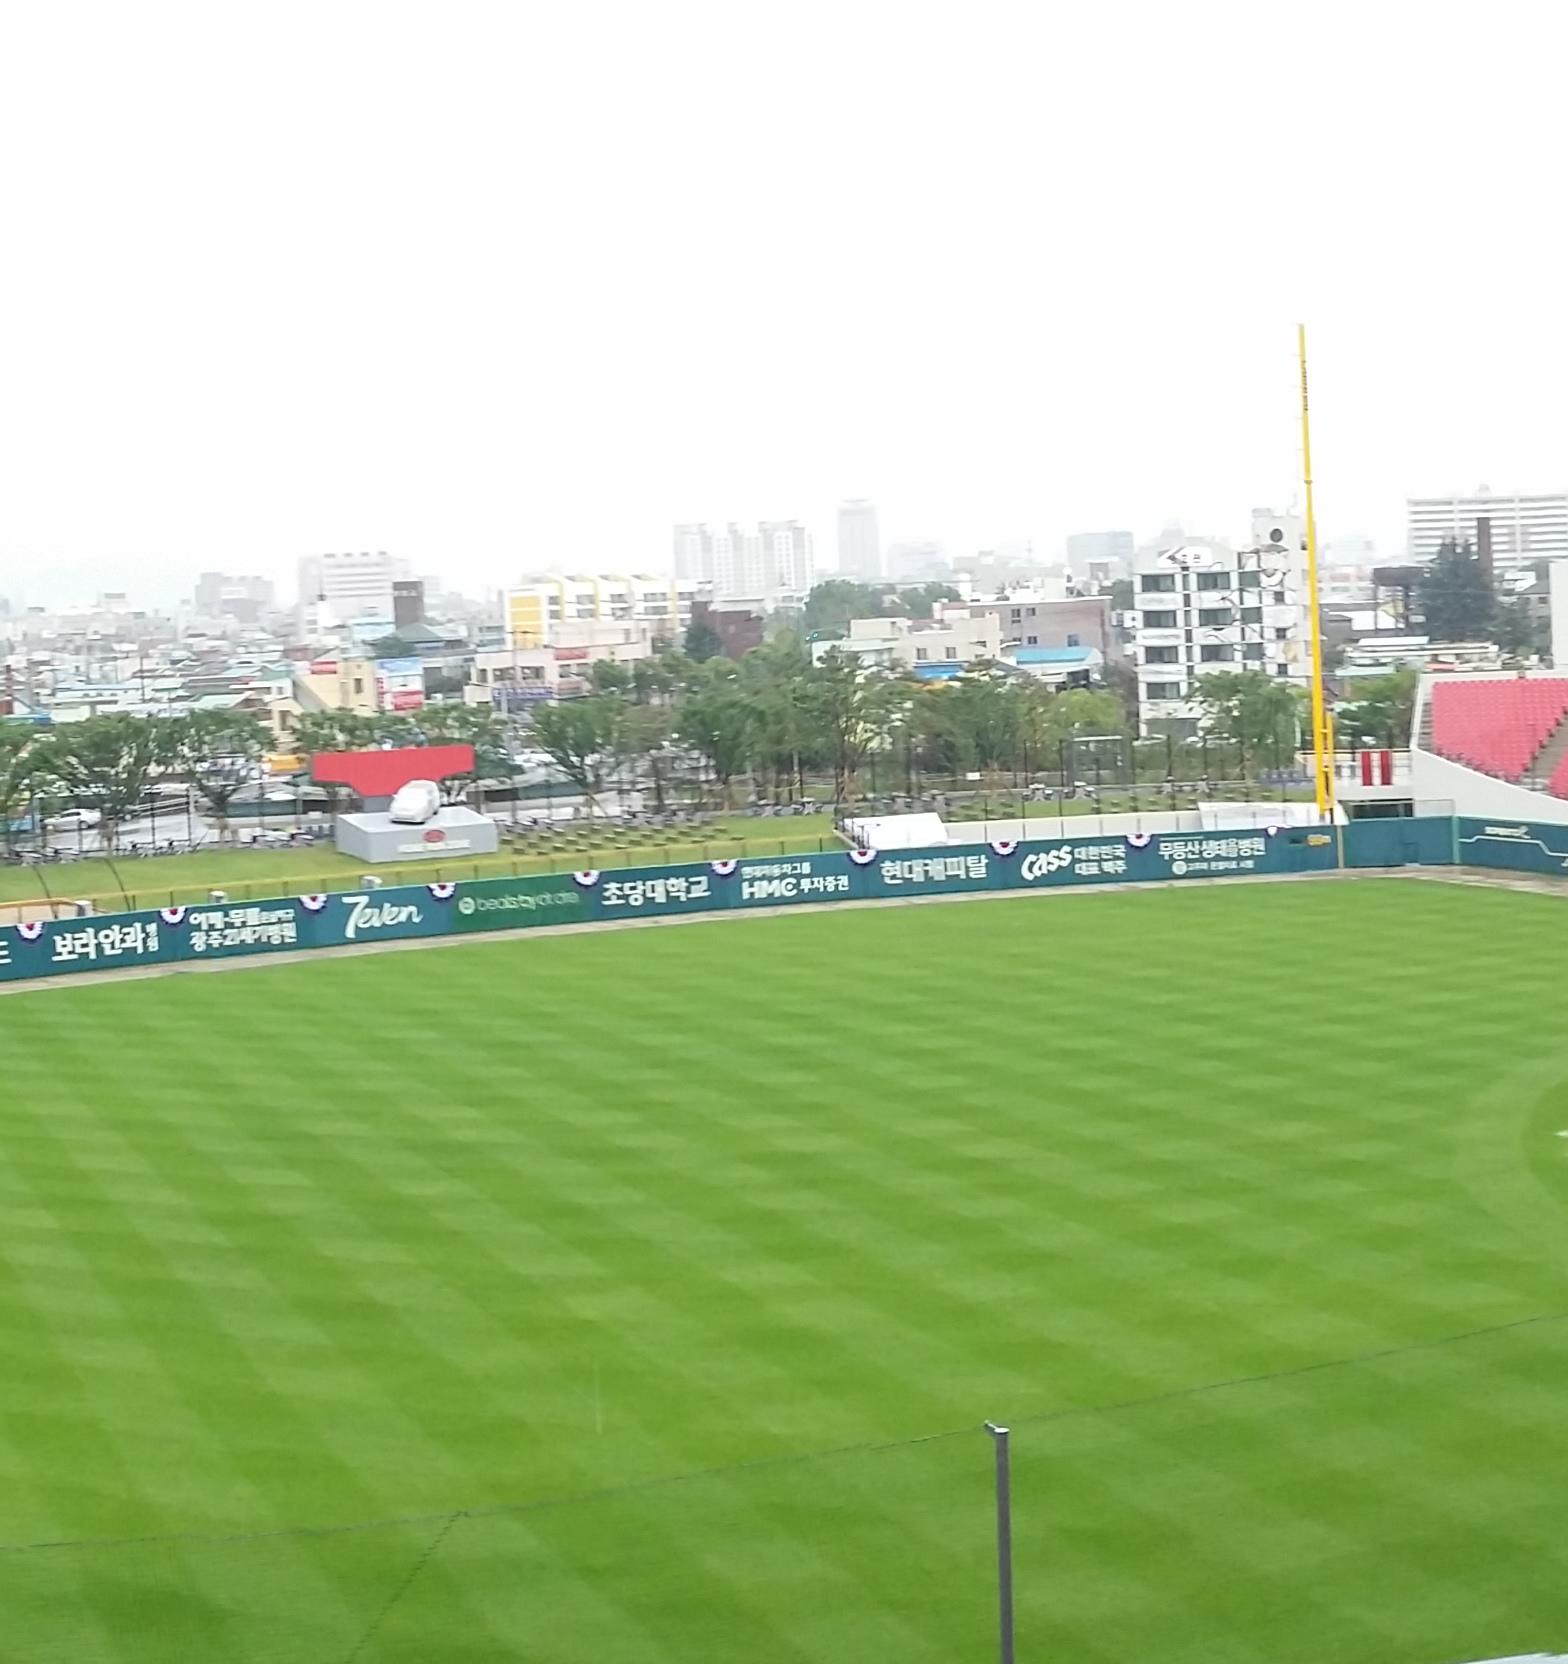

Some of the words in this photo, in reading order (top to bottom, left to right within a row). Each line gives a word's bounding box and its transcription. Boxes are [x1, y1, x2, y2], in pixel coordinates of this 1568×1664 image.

[602, 875, 712, 907] 초당대학교
[742, 878, 798, 900] HMC
[800, 875, 850, 893] 투자증권
[52, 921, 145, 962] 보라안과
